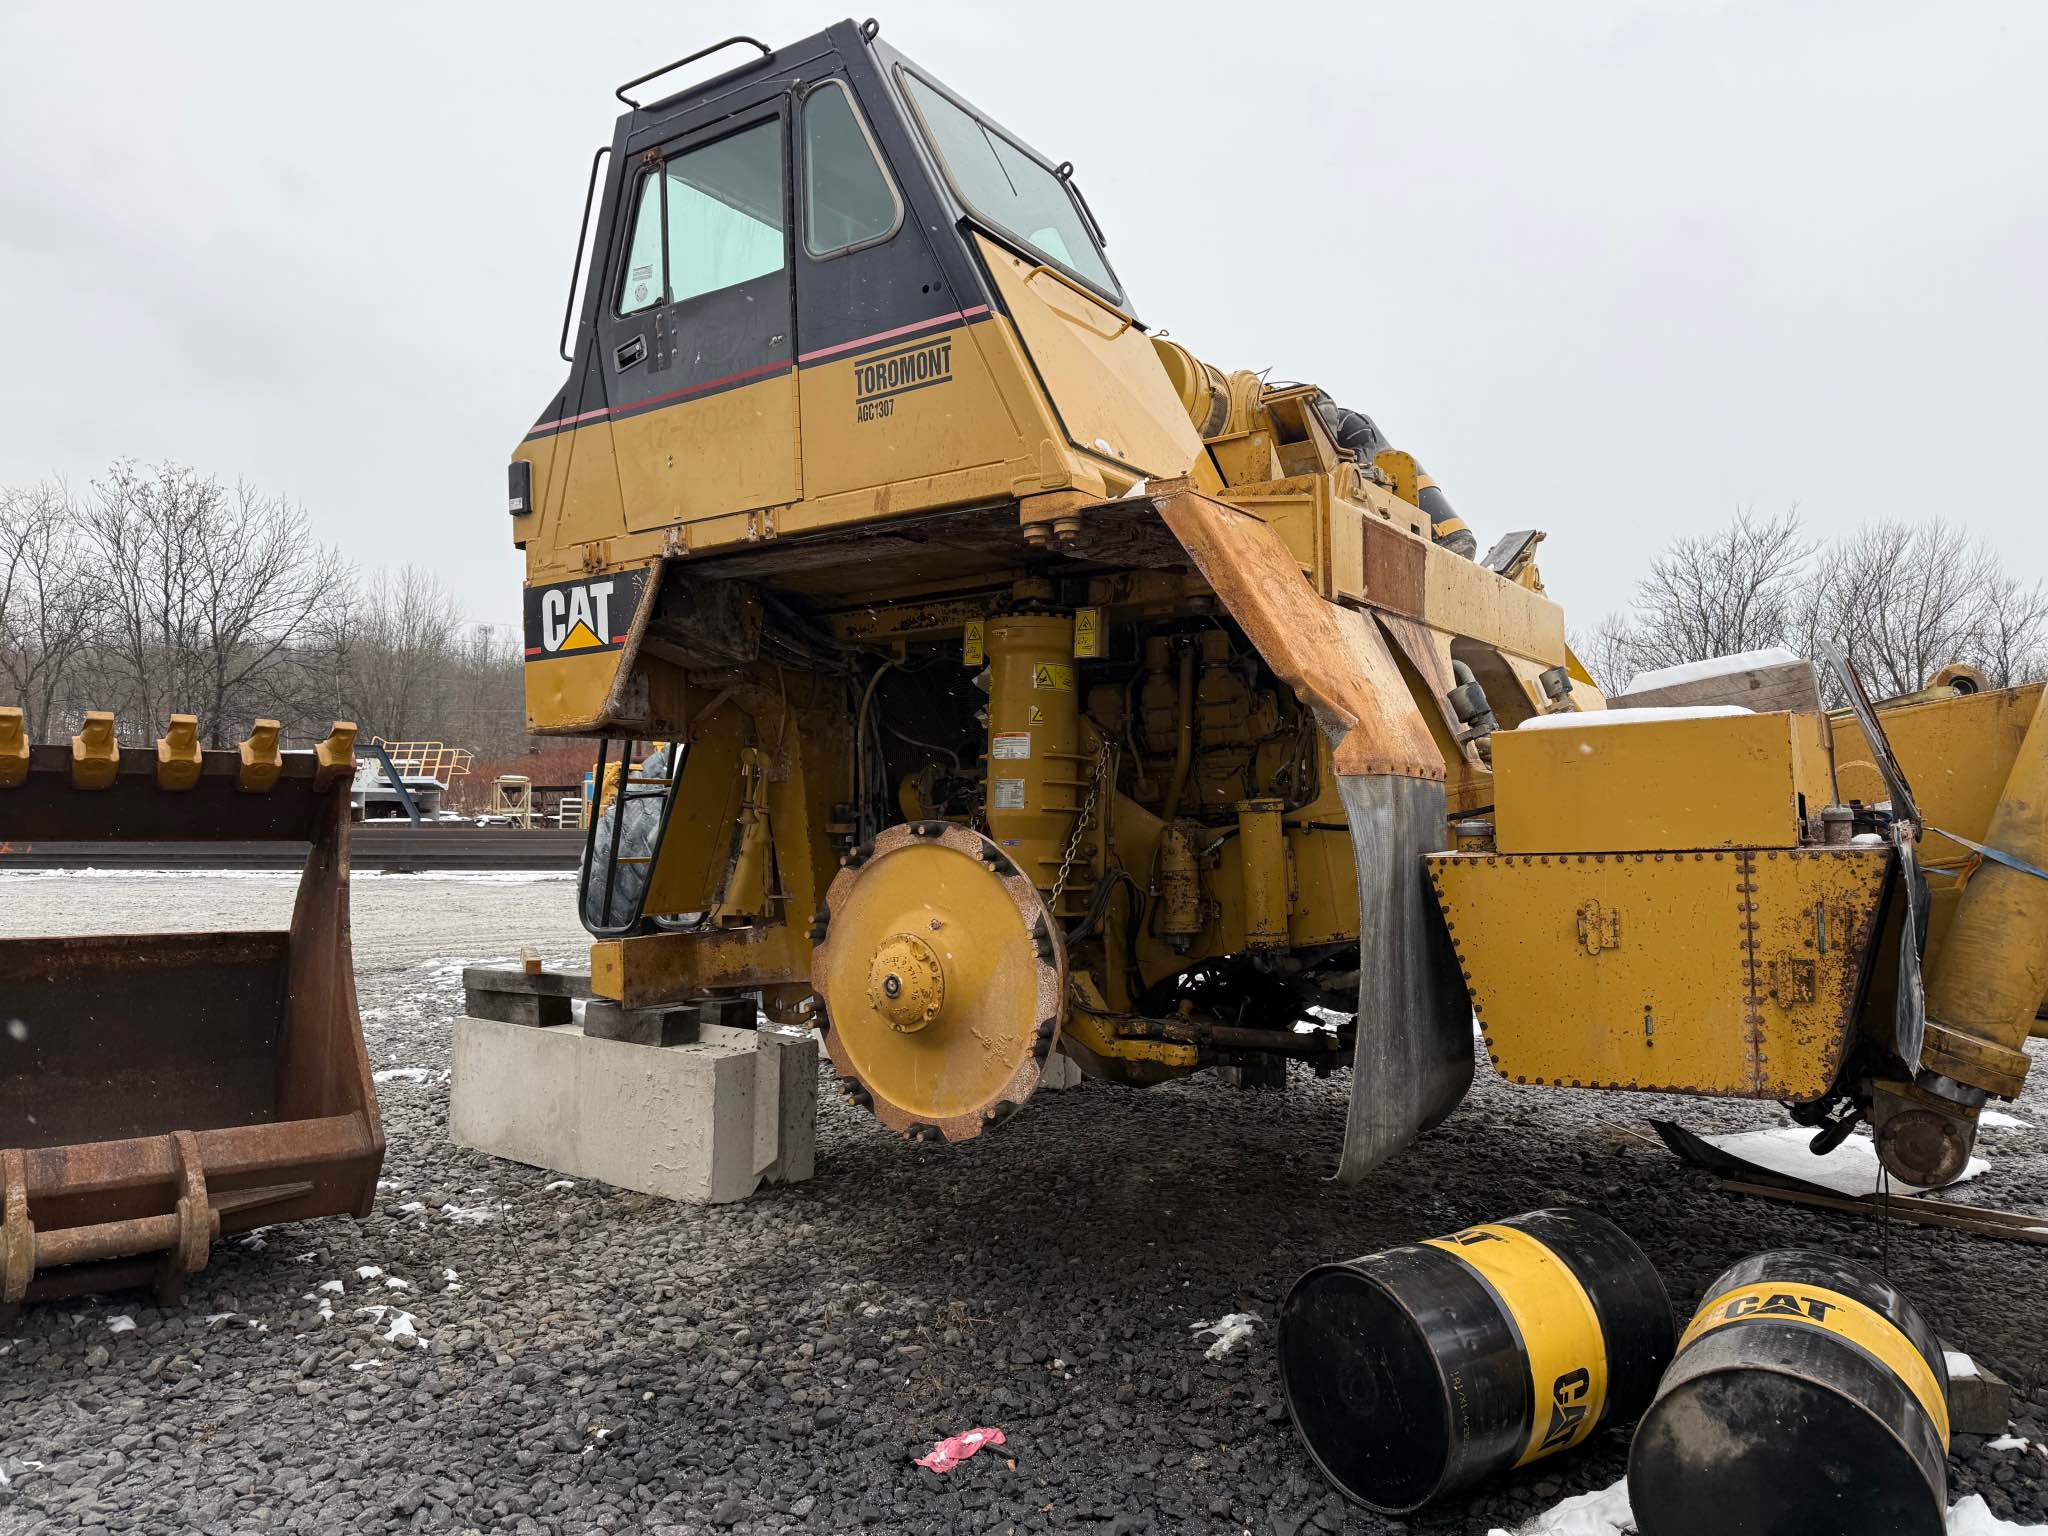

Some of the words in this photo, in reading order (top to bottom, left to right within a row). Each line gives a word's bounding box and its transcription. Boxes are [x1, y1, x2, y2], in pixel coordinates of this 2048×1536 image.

[854, 345, 952, 396] TOROMONT
[857, 399, 895, 424] AGC1307
[542, 581, 614, 651] CAT
[1724, 1294, 1836, 1323] CAT
